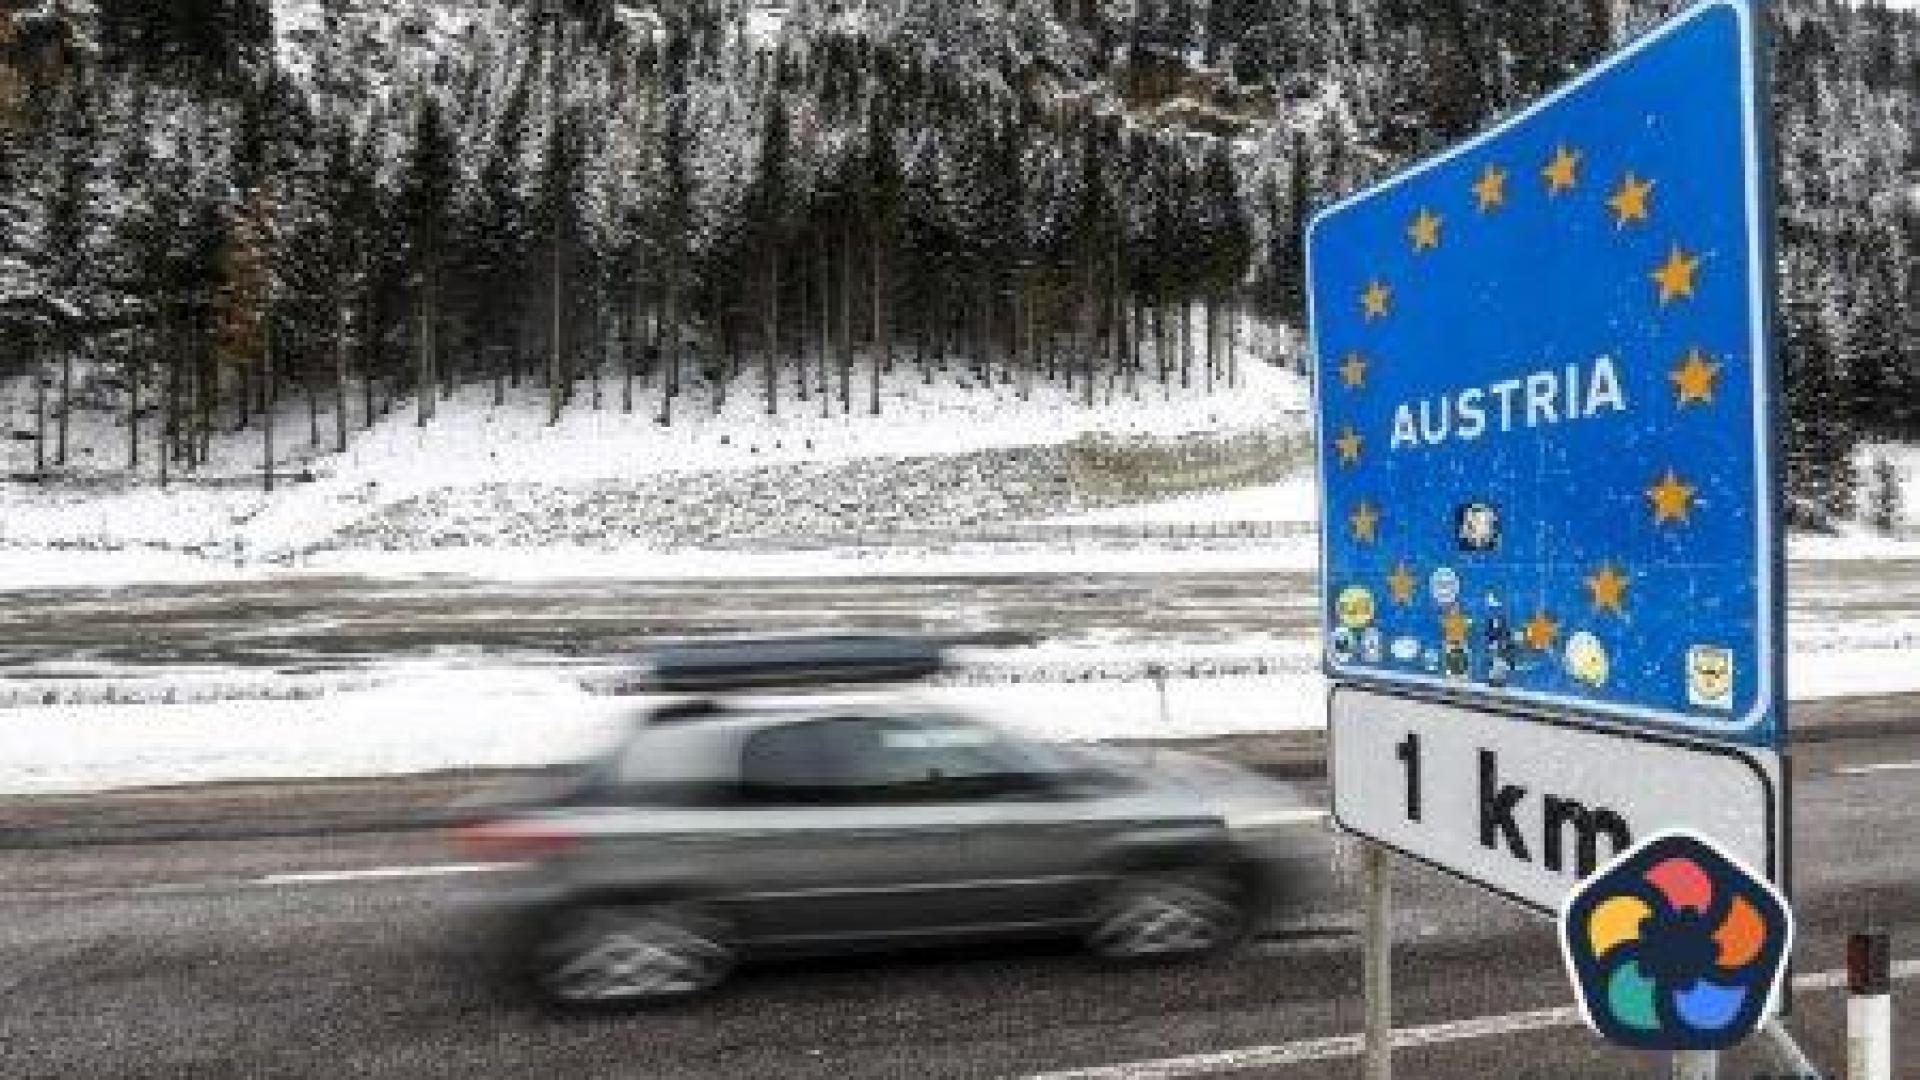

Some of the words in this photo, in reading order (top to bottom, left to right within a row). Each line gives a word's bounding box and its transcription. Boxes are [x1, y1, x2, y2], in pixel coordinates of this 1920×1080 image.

[1391, 354, 1626, 449] AUSTRIA
[1395, 732, 1422, 822] 1
[1477, 747, 1633, 877] km
